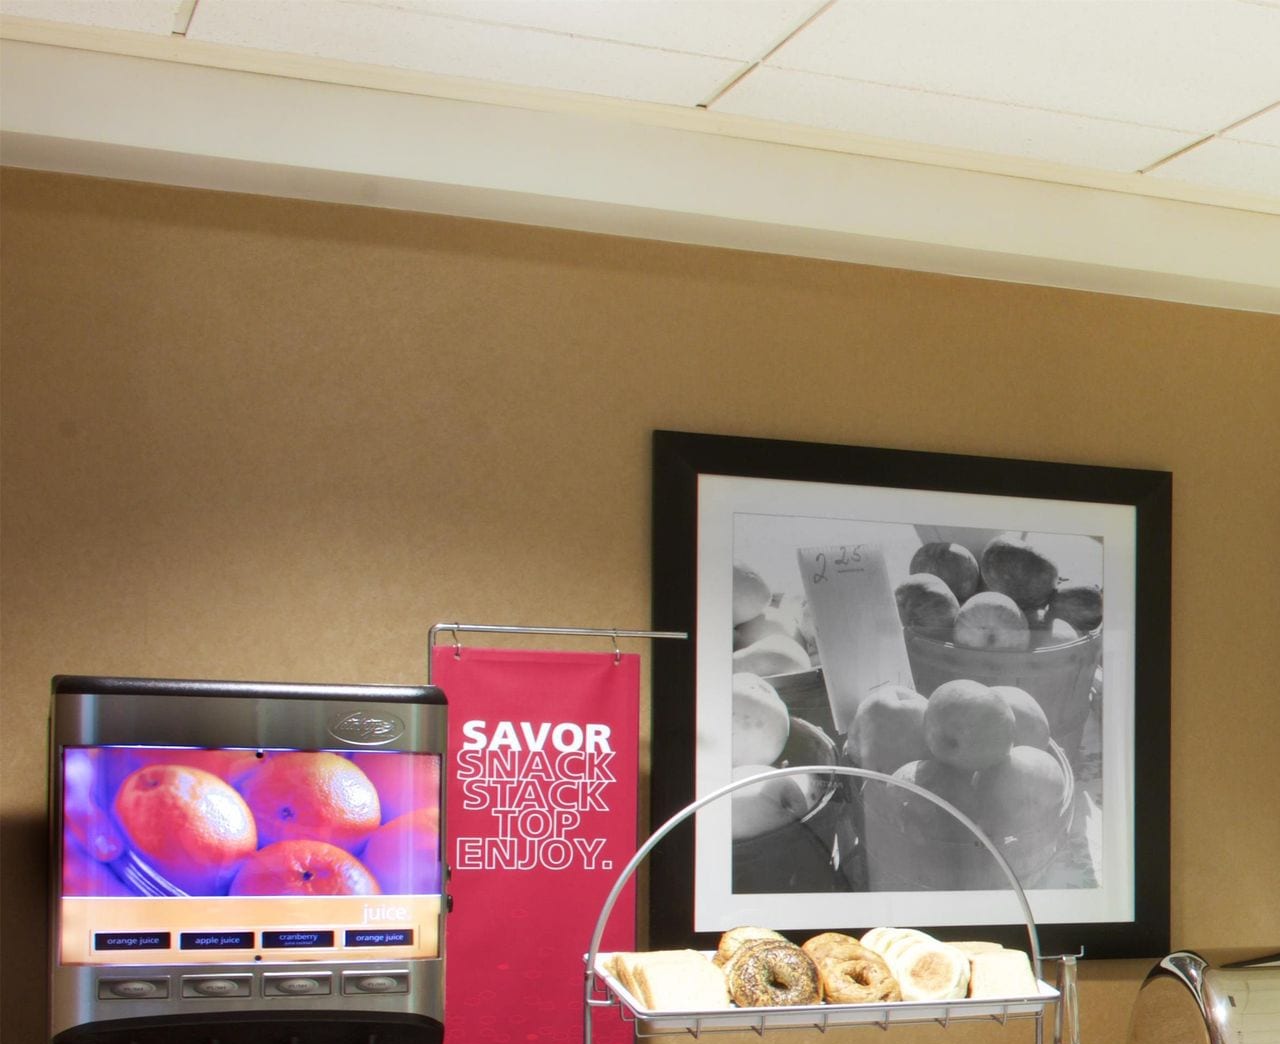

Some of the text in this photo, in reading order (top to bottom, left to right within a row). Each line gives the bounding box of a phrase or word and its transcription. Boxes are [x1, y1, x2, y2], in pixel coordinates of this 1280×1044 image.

[462, 720, 613, 753] SAVOR
[456, 749, 617, 783] SNACK
[463, 778, 610, 812] STACK
[491, 807, 581, 841] TOP
[456, 837, 613, 870] ENJOY.
[107, 935, 160, 946] orange juice
[194, 935, 241, 946] apple juice
[279, 932, 319, 942] cranberry
[355, 931, 404, 943] orange juice
